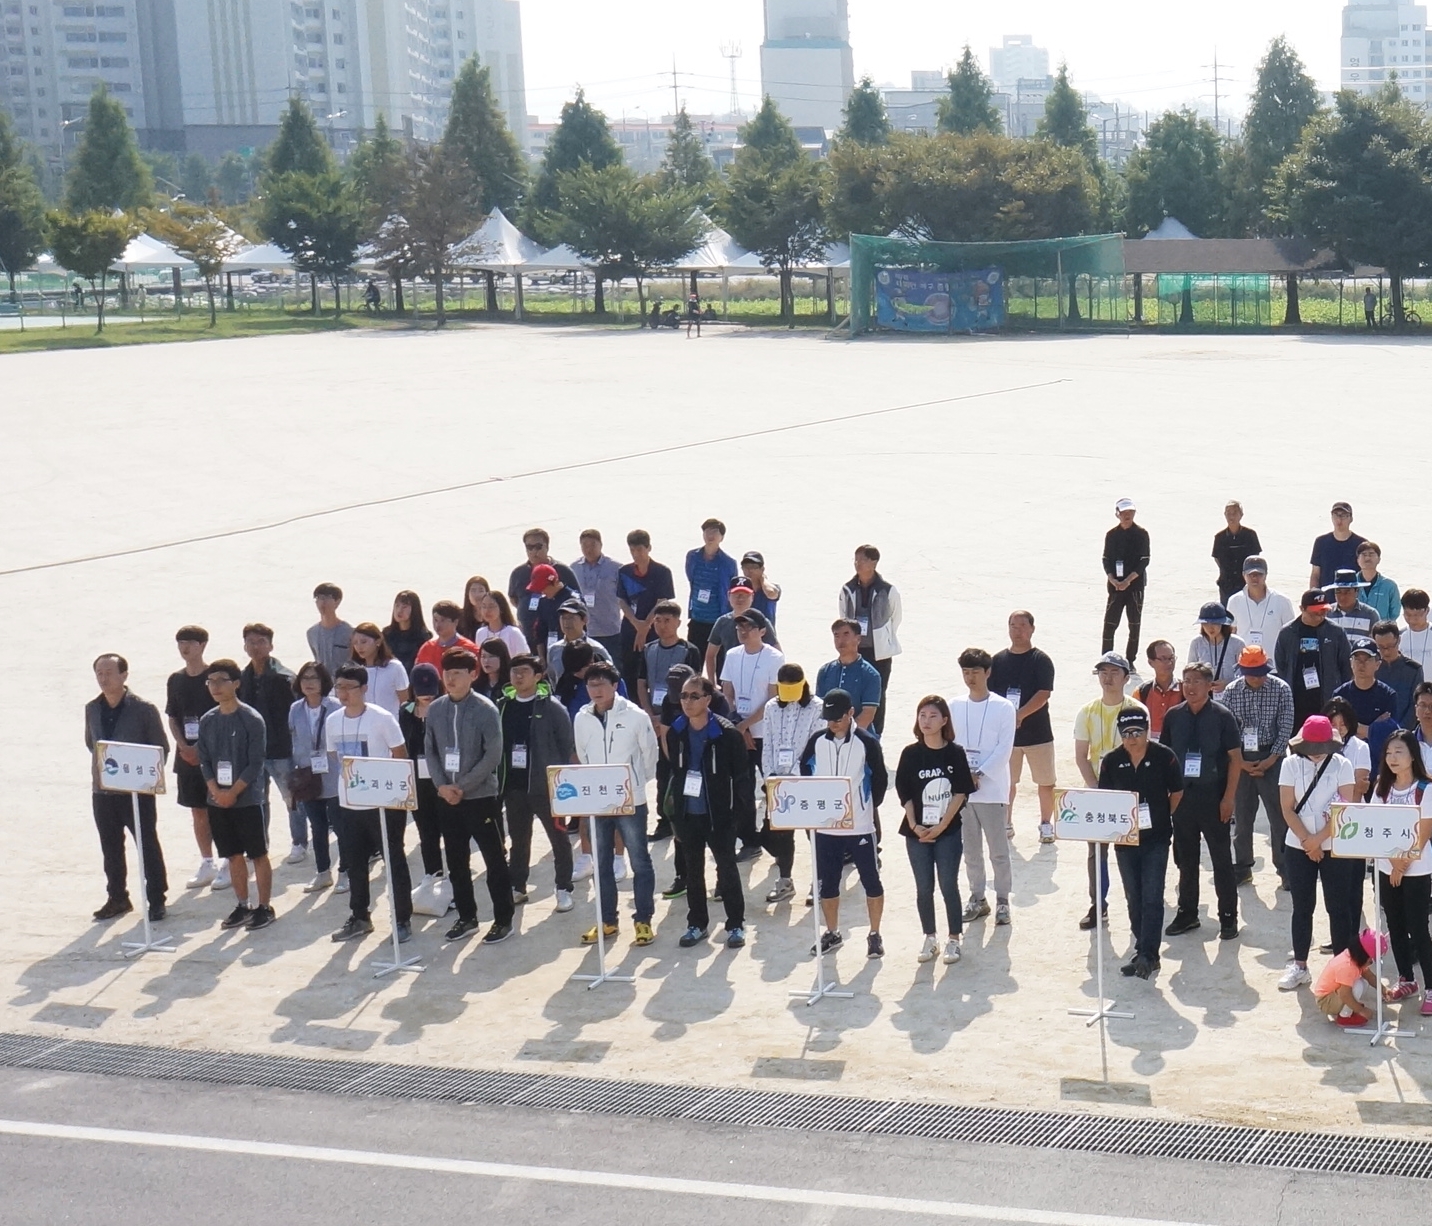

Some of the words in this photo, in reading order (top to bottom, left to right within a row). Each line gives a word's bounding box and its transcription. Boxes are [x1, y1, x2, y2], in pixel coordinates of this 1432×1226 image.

[918, 765, 954, 779] GRAPC
[371, 779, 407, 791] 괴산군
[581, 784, 625, 796] 진천군
[800, 799, 843, 811] 증평군
[1085, 811, 1129, 824] 충청북도
[1364, 827, 1411, 839] 청주시
